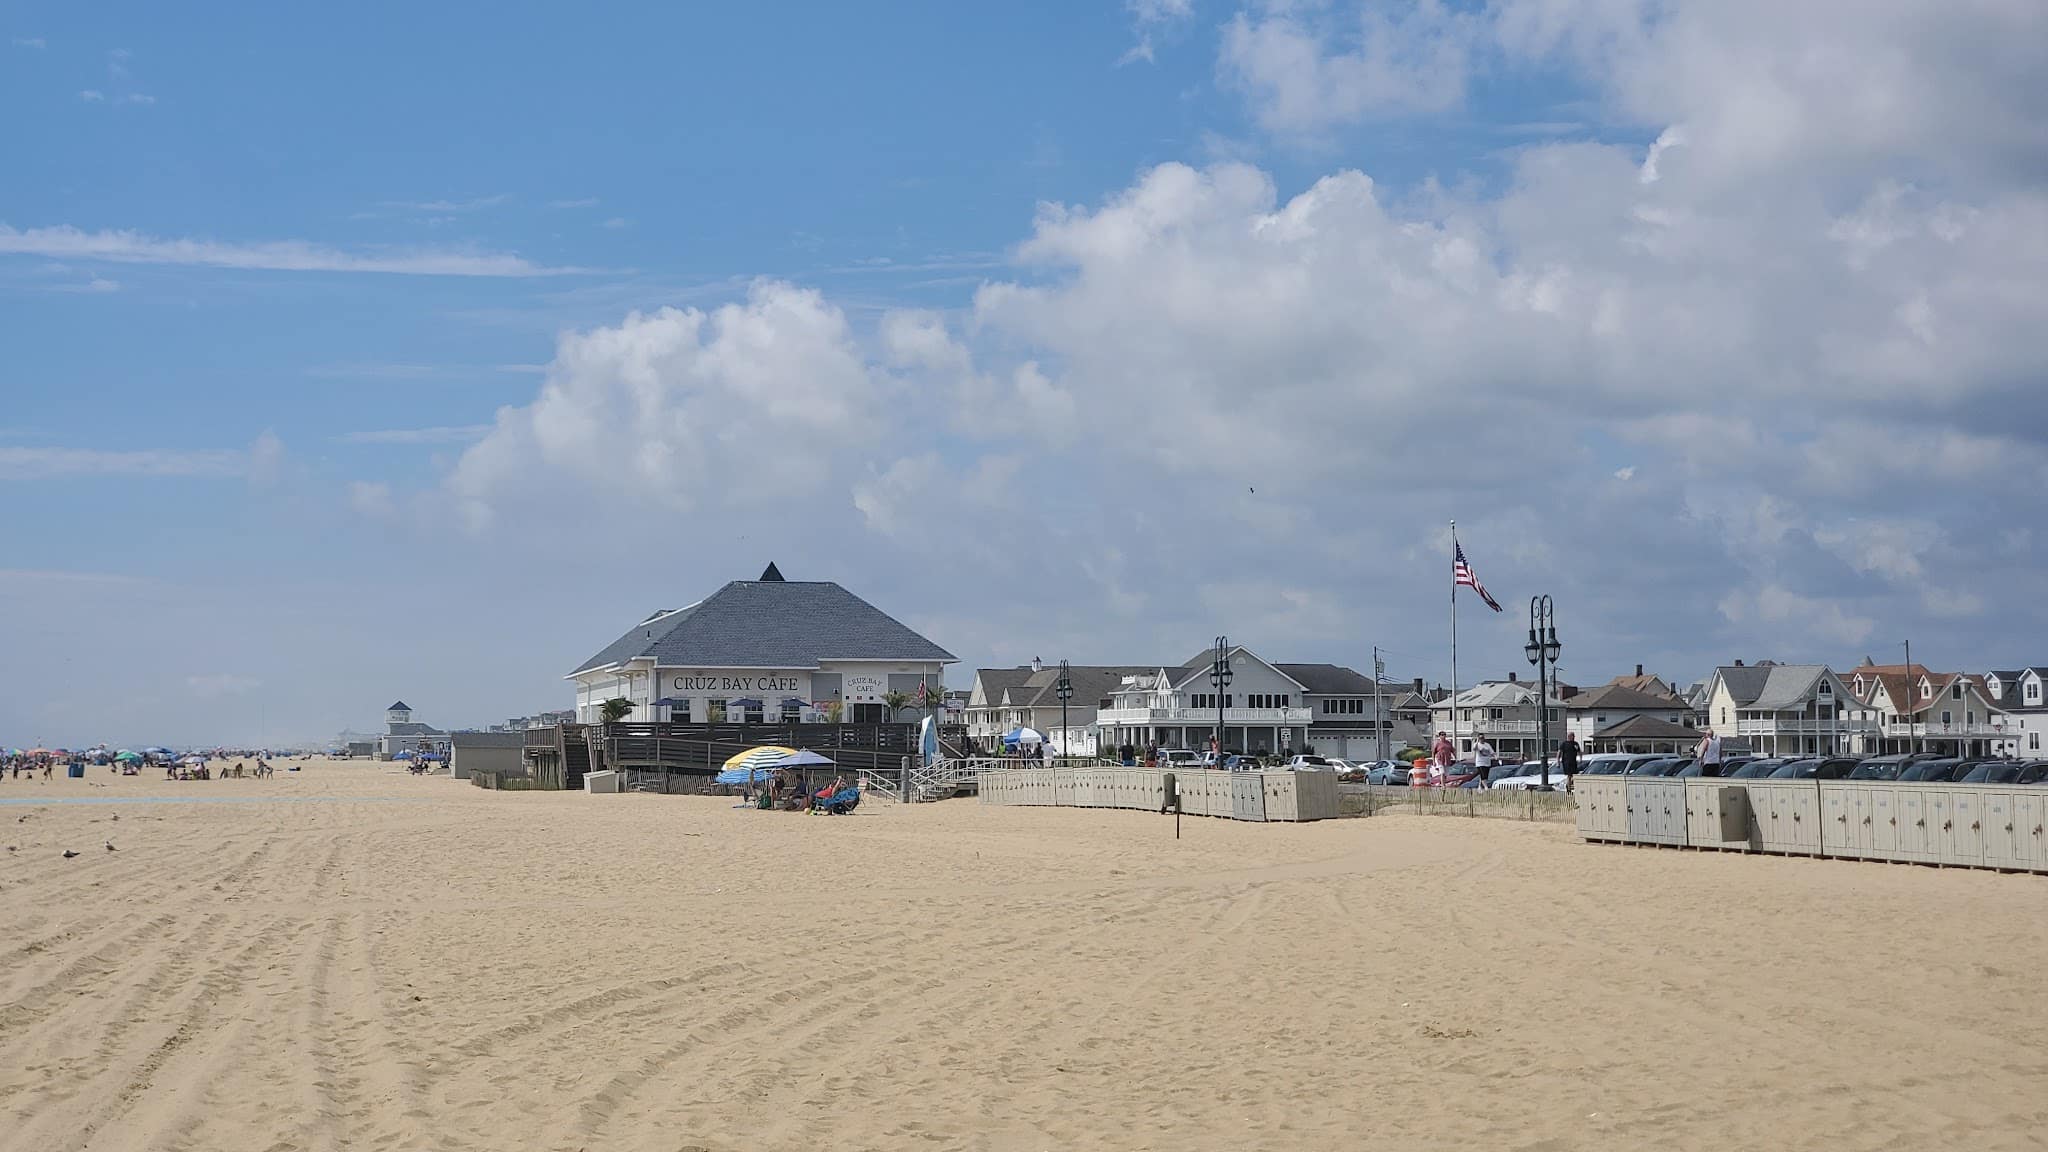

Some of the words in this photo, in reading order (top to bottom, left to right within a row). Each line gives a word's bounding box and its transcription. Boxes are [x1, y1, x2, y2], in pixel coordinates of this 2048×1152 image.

[674, 677, 717, 690] CRUZ
[722, 677, 752, 690] BAY
[757, 677, 798, 690] CAFE
[847, 677, 866, 687] CRUZ
[868, 678, 883, 687] BAY
